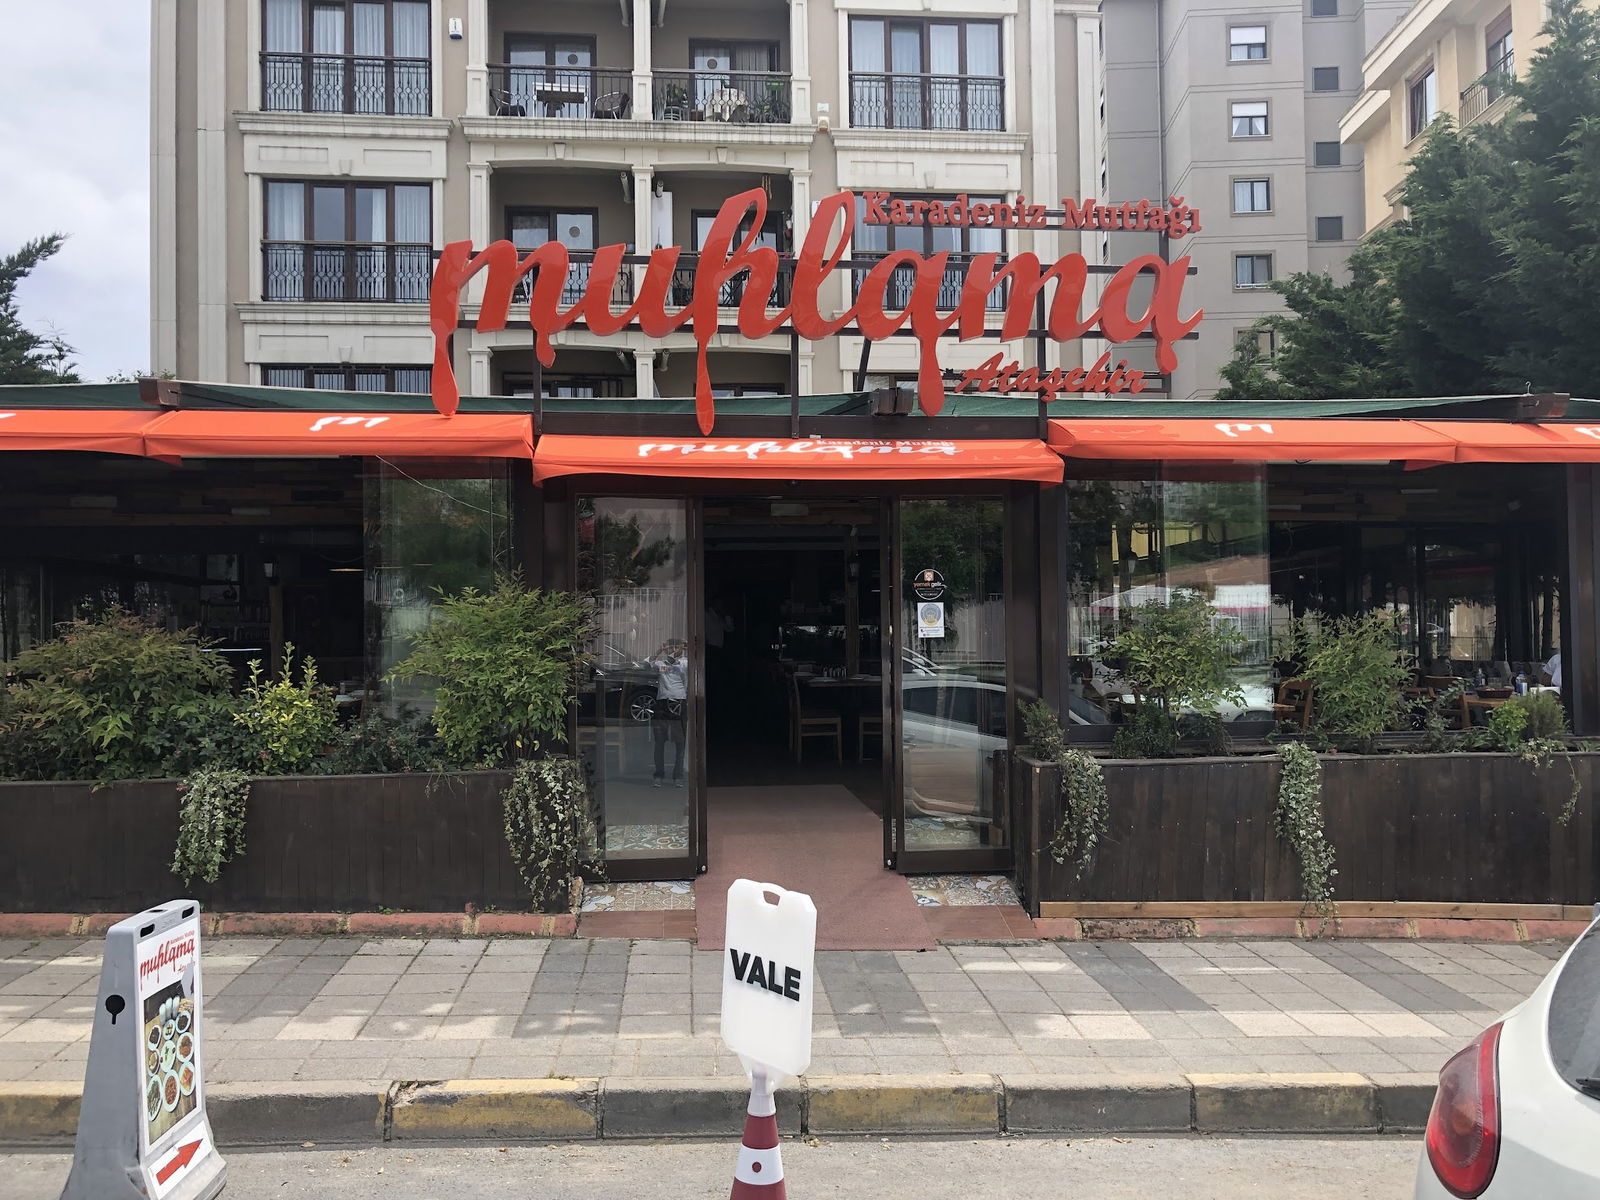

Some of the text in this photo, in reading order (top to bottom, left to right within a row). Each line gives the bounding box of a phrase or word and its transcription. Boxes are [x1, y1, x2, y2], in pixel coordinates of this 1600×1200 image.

[863, 191, 1203, 239] Karadeniz Mutfağı
[430, 186, 1204, 437] muhlama
[954, 351, 1149, 402] Ataşehir
[637, 441, 964, 459] muhlama
[140, 937, 196, 992] muhlama
[730, 948, 801, 1002] VALE
